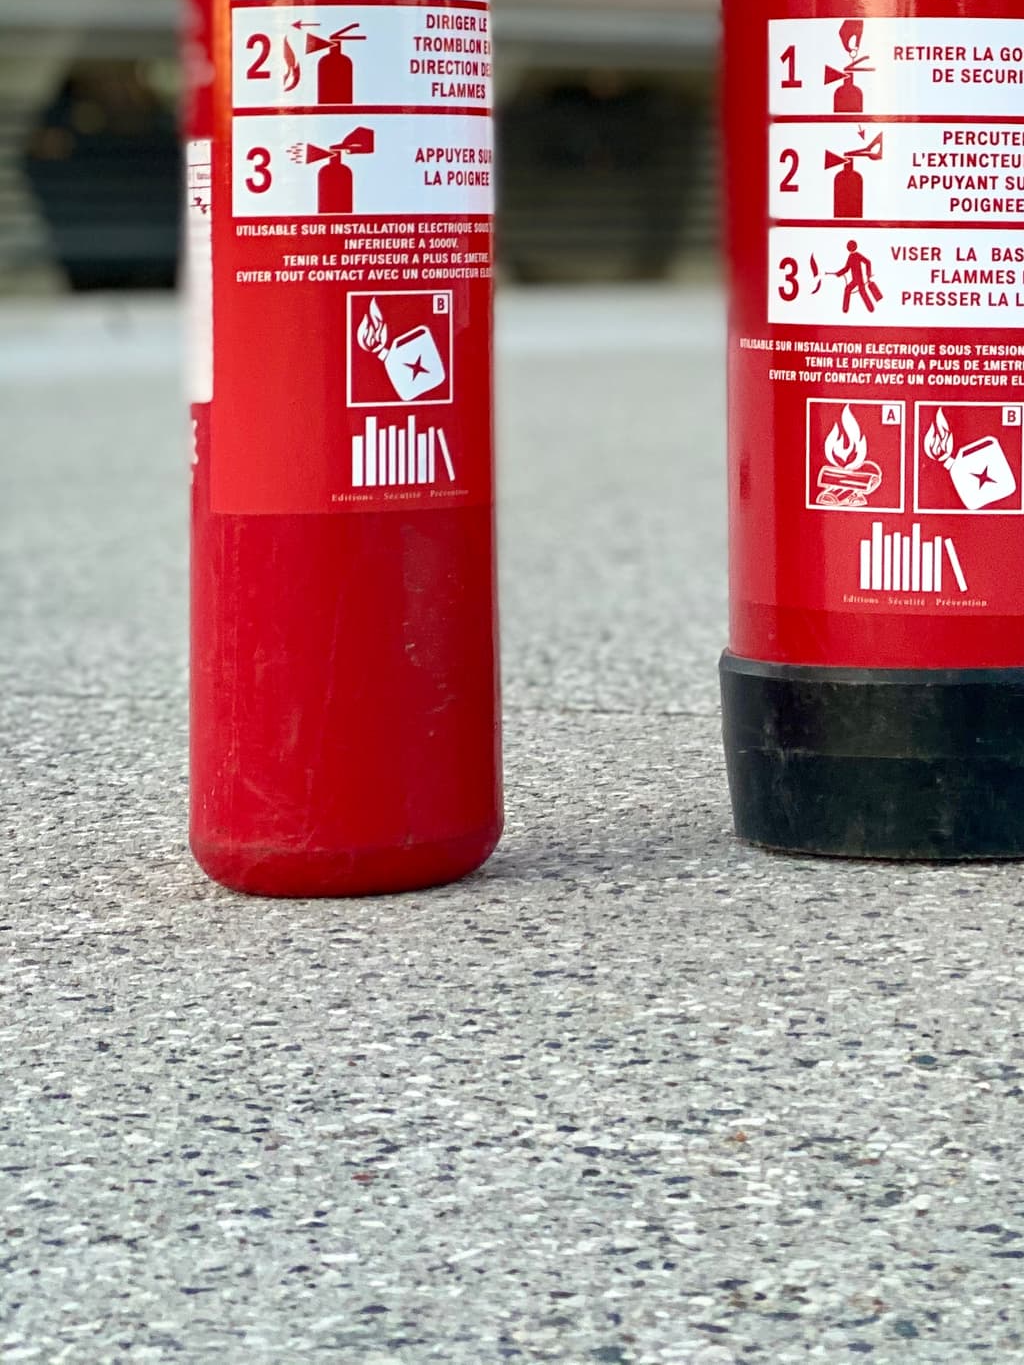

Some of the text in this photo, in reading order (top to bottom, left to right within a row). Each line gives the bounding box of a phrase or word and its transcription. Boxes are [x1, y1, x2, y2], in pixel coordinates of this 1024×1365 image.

[426, 13, 488, 33] DIRIGER LE
[413, 36, 482, 55] TROMBLON
[893, 45, 967, 61] RETIRER
[973, 46, 994, 62] LA
[246, 33, 271, 80] 2
[409, 58, 479, 77] DIRECTION
[780, 45, 803, 89] 1
[932, 68, 955, 83] DE
[431, 81, 486, 100] FLAMMES
[414, 147, 476, 164] APPUYER
[245, 146, 273, 194] 3
[779, 148, 800, 193] 2
[424, 170, 490, 187] LA POIGNEE
[906, 174, 999, 190] APPUYANT
[949, 197, 1024, 213] POIGNEE
[236, 222, 473, 237] UTILISABLE SUR INSTALLATION ELECTRIQUE
[344, 237, 416, 250] INFERIEURE
[418, 238, 426, 249] A
[282, 252, 463, 267] TENIR LE DIFFUSEUR A PLUS DE
[890, 246, 942, 262] VISER
[955, 246, 977, 262] LA
[236, 267, 479, 283] EVITER TOUT CONTACT AVEC UN CONDUCTEUR
[778, 256, 800, 302] 3
[930, 269, 1016, 285] FLAMMES
[437, 297, 445, 312] B
[901, 291, 981, 307] PRESSER
[988, 292, 1009, 307] LA
[775, 340, 793, 352] SUR
[794, 341, 863, 354] INSTALLATION
[865, 343, 936, 357] ELECTRIQUE
[938, 344, 972, 356] SOUS
[805, 356, 834, 368] TENIR
[836, 357, 849, 369] LE
[851, 357, 915, 370] DIFFUSEUR
[917, 359, 926, 371] A
[929, 359, 961, 371] PLUS
[963, 359, 980, 371] DE
[768, 369, 797, 381] EVITER
[798, 370, 823, 383] TOUT
[824, 371, 872, 384] CONTACT
[874, 373, 904, 385] AVEC
[907, 374, 924, 385] UN
[927, 374, 1008, 386] CONDUCTEUR
[886, 408, 896, 422] A
[1007, 409, 1017, 423] B
